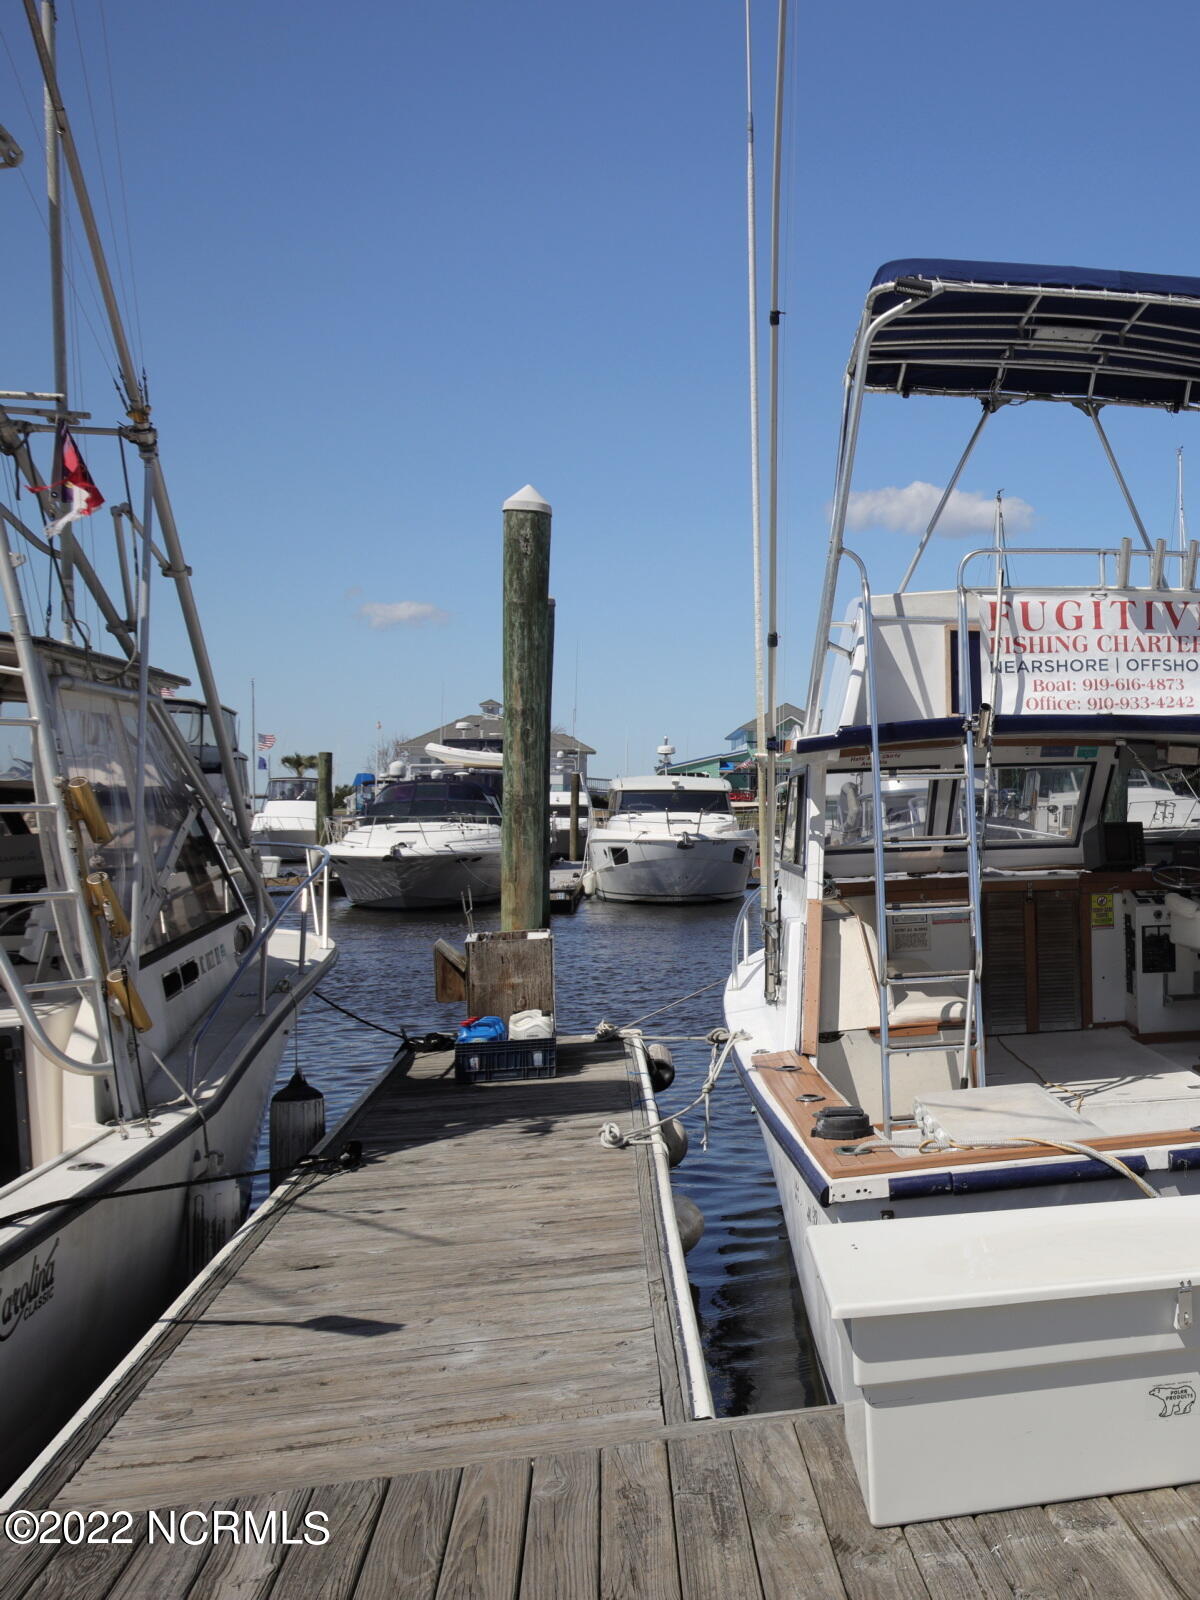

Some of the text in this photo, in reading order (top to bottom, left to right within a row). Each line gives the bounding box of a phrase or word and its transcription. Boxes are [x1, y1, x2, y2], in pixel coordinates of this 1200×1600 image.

[989, 635, 1088, 655] FISHING
[989, 658, 1109, 674] NEARSHORE
[1033, 678, 1185, 693] Boat: 919-616-4873
[1025, 696, 1195, 711] Office: 910-933-4242
